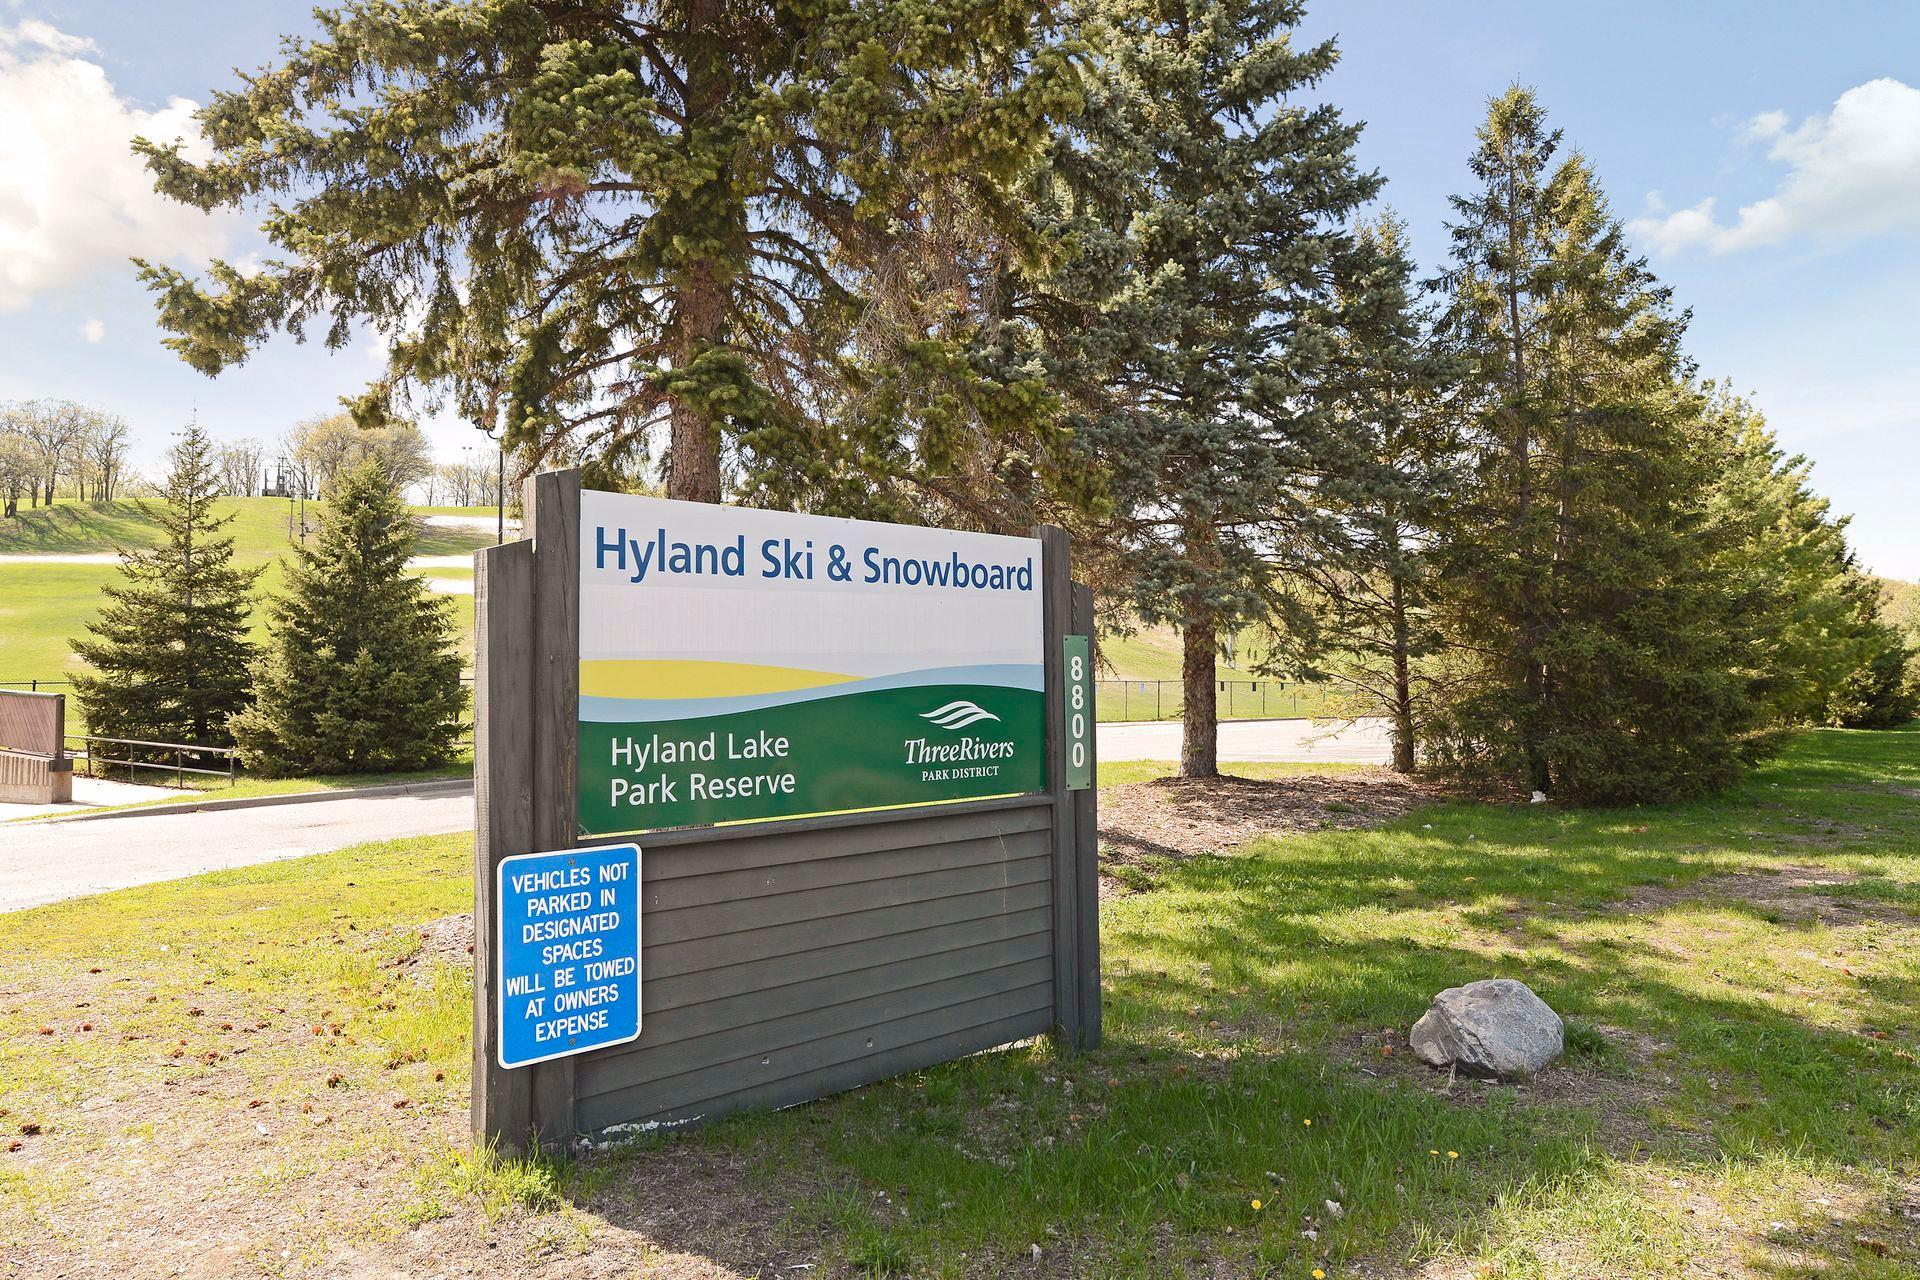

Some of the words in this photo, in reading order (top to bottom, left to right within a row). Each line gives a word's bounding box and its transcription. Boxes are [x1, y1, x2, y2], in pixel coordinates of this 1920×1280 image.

[596, 526, 746, 583] Hyland
[760, 538, 814, 580] Ski
[826, 543, 853, 583] &
[863, 546, 1034, 592] Snowboard
[1070, 655, 1085, 768] 8800
[610, 732, 716, 773] Hyland
[724, 729, 790, 760] Lake
[904, 736, 1015, 765] ThreeRivers
[610, 773, 677, 807] Park
[689, 770, 796, 802] Reserve
[921, 769, 949, 782] PARK
[952, 764, 1000, 779] DISTRICT
[512, 867, 591, 894] VEHICLES
[600, 862, 630, 882] NOT
[527, 891, 592, 918] PARKED
[600, 887, 616, 907] IN
[522, 911, 620, 944] DESIGNATED
[541, 938, 603, 966] SPACES
[506, 973, 546, 997] WILL
[554, 967, 576, 989] BE
[583, 956, 635, 982] TOWED
[524, 997, 546, 1020] AT
[554, 983, 619, 1014] OWNERS
[535, 1009, 609, 1043] EXPENSE
